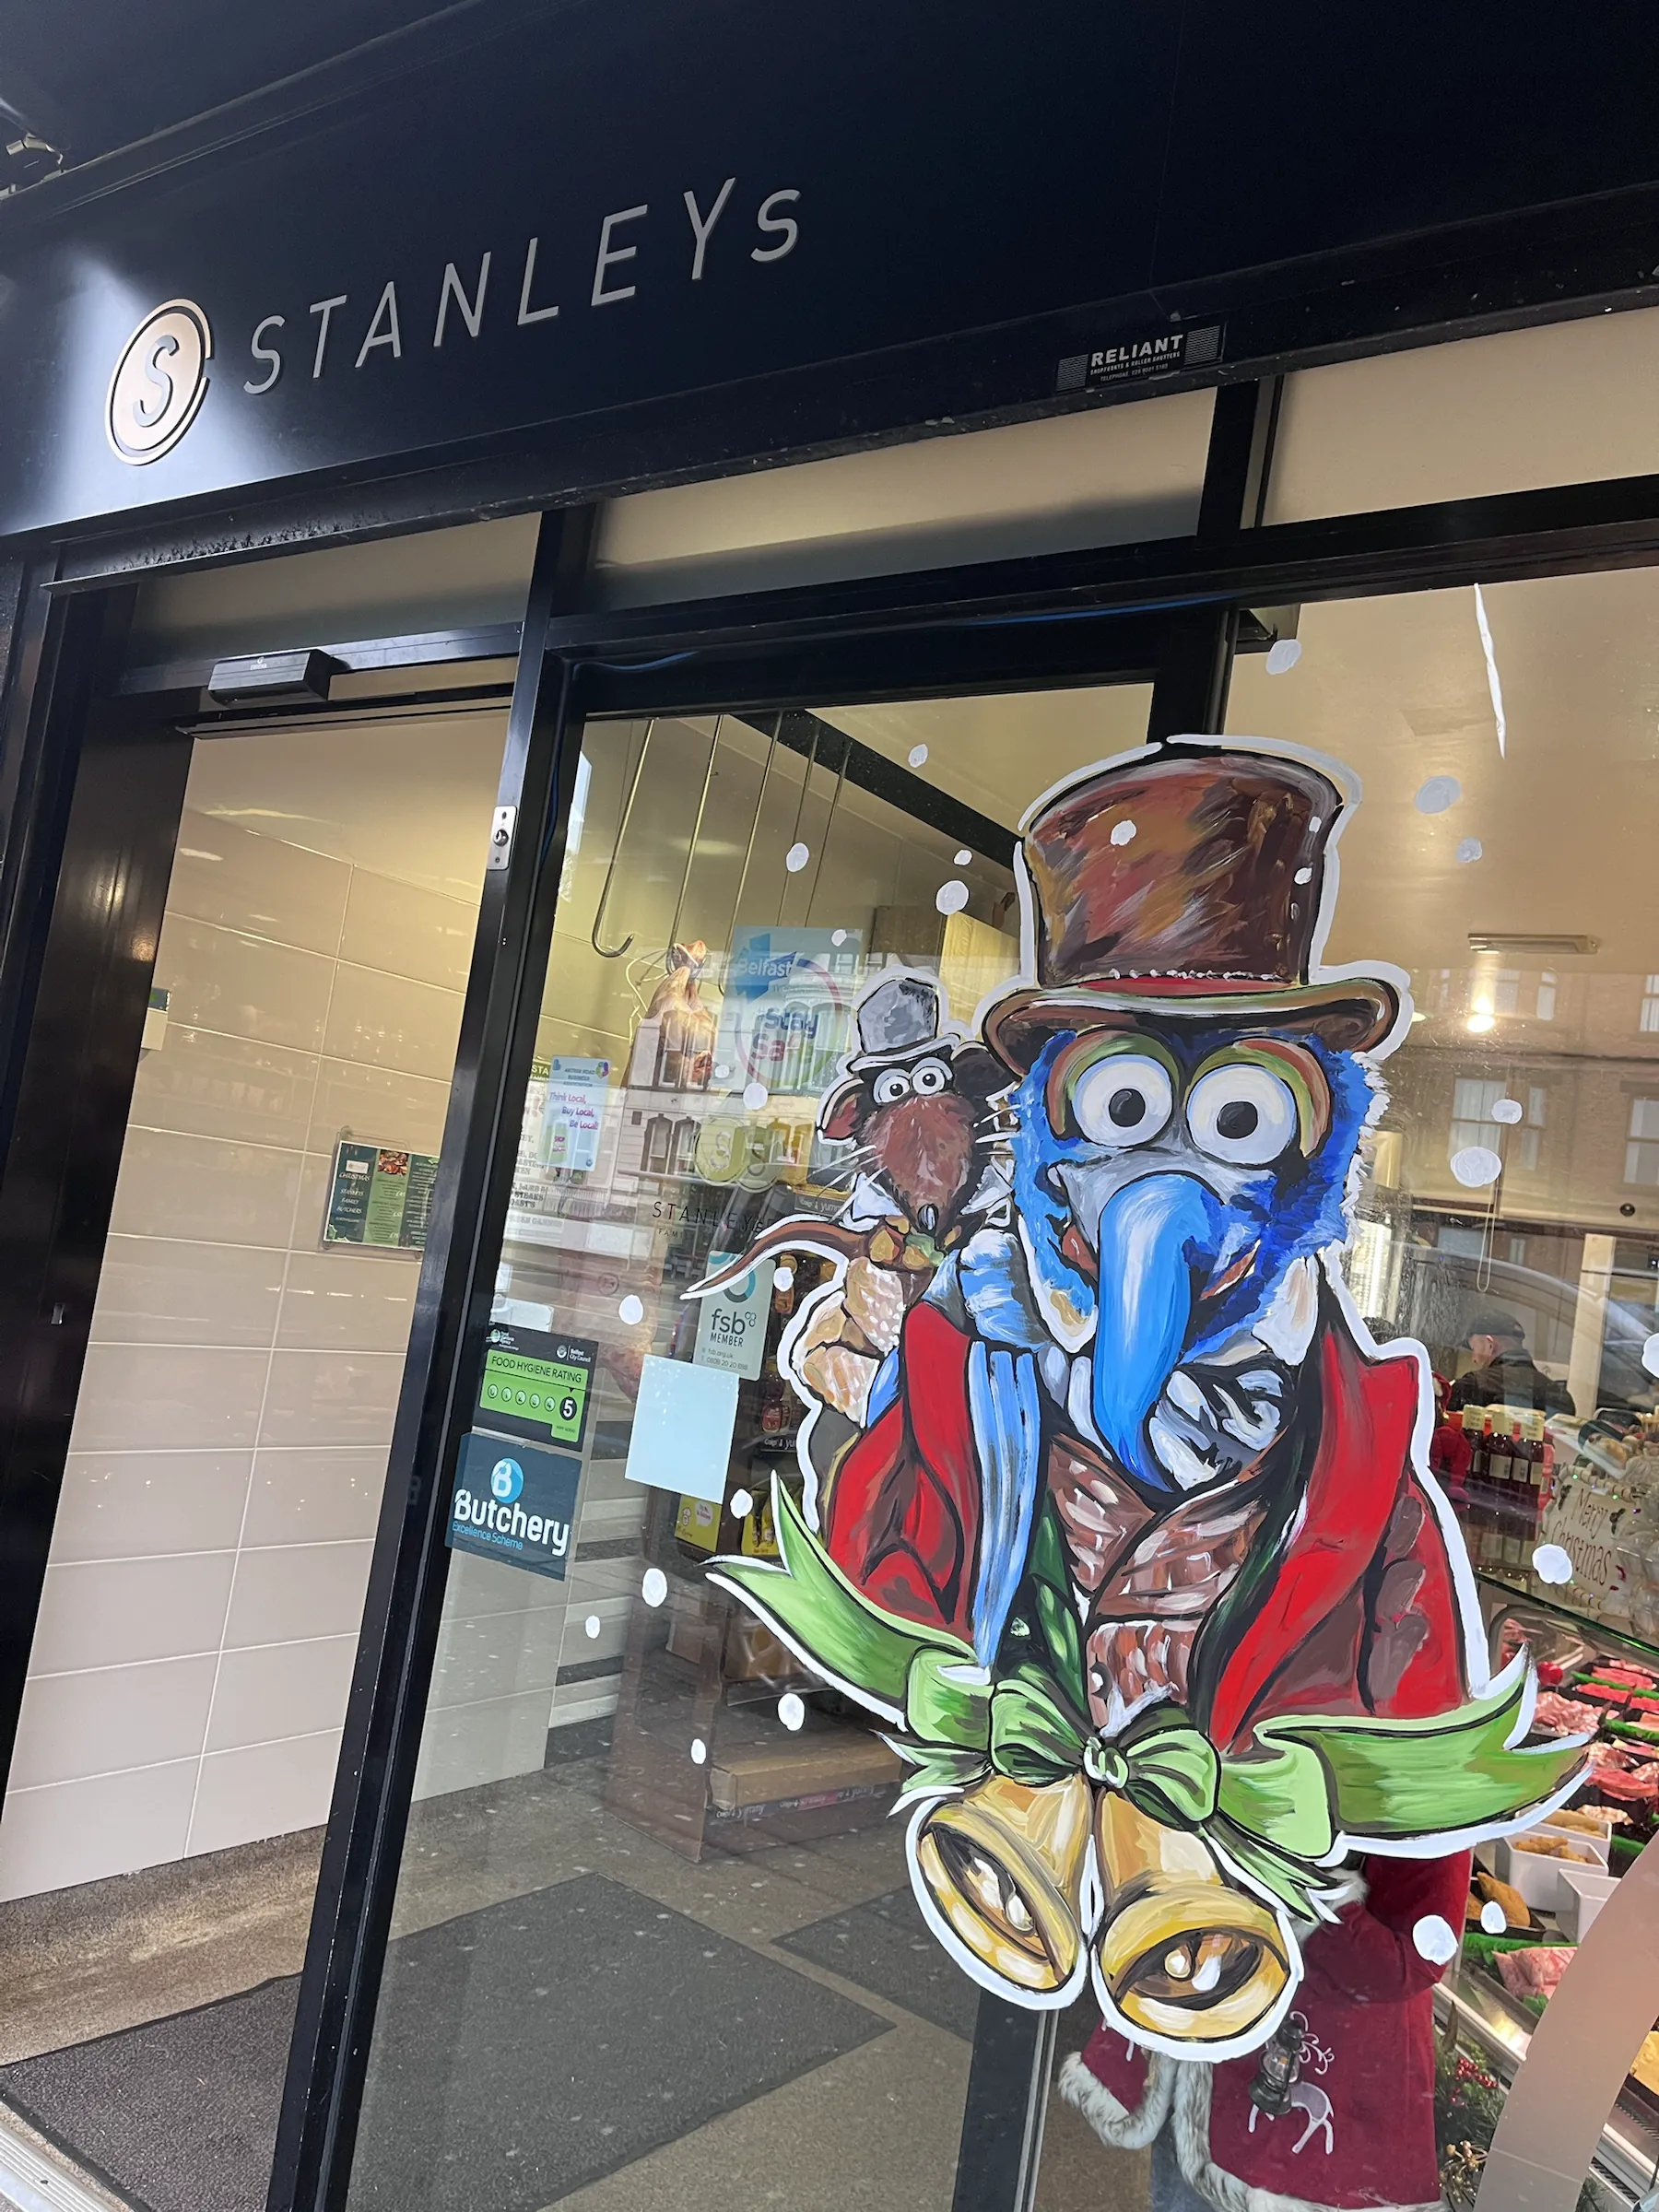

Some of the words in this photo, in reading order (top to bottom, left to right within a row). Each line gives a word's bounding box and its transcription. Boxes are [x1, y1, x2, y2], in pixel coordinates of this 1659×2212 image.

[1091, 335, 1183, 367] RELIANT
[1131, 358, 1151, 366] ROLLER
[1152, 351, 1180, 362] SHUTTERS
[738, 958, 793, 977] Belfast
[549, 1092, 568, 1101] Think
[562, 1106, 574, 1116] Buy
[712, 1309, 745, 1335] fsb
[710, 1333, 743, 1347] MEMBER
[492, 1356, 515, 1369] FOOD
[517, 1362, 550, 1377] HYGIENE
[552, 1369, 582, 1382] RATING
[563, 1399, 573, 1418] 5
[454, 1489, 570, 1557] Butchery
[1571, 1488, 1608, 1539] Merry
[453, 1521, 491, 1541] Excellence
[492, 1532, 523, 1550] Scheme
[1551, 1516, 1611, 1585] Christmas
